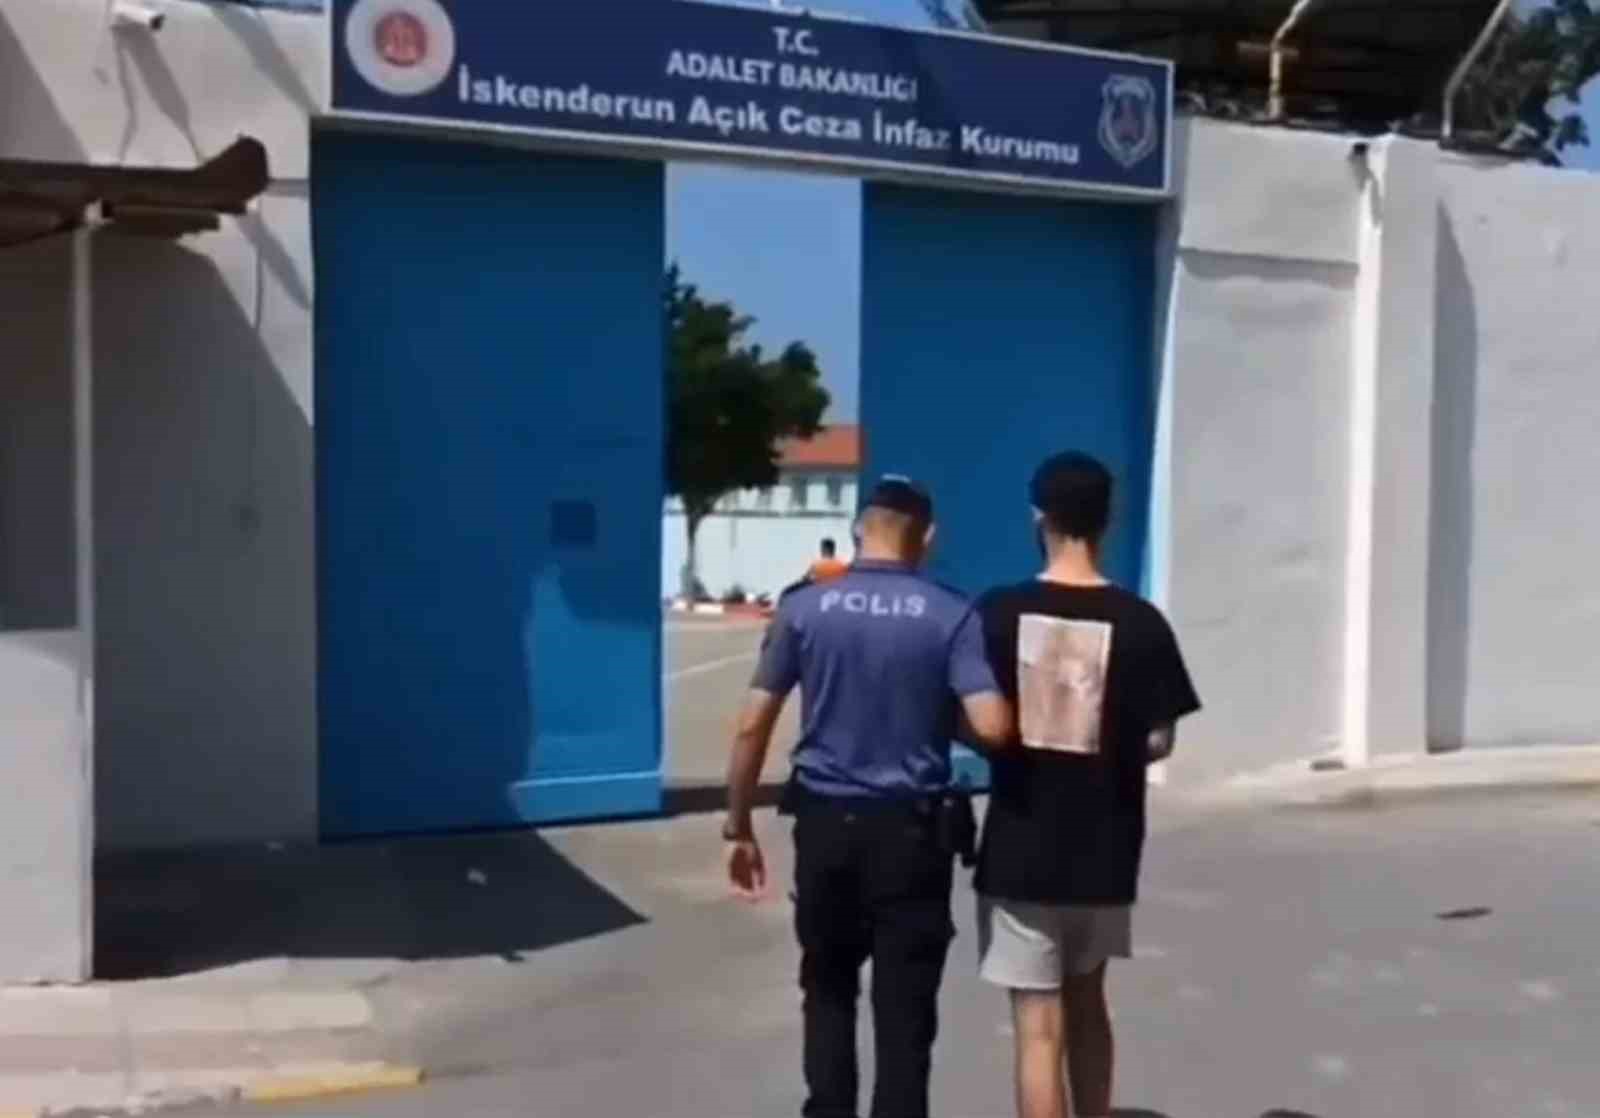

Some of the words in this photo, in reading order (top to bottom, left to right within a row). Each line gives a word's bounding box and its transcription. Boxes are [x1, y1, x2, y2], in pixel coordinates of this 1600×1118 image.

[773, 27, 819, 57] T.C.
[666, 50, 774, 85] ADALET
[458, 65, 675, 122] İskenderun
[688, 98, 768, 134] Açık
[779, 107, 860, 140] Ceza
[873, 111, 950, 150] İnfaz
[961, 126, 1080, 165] Kurumu
